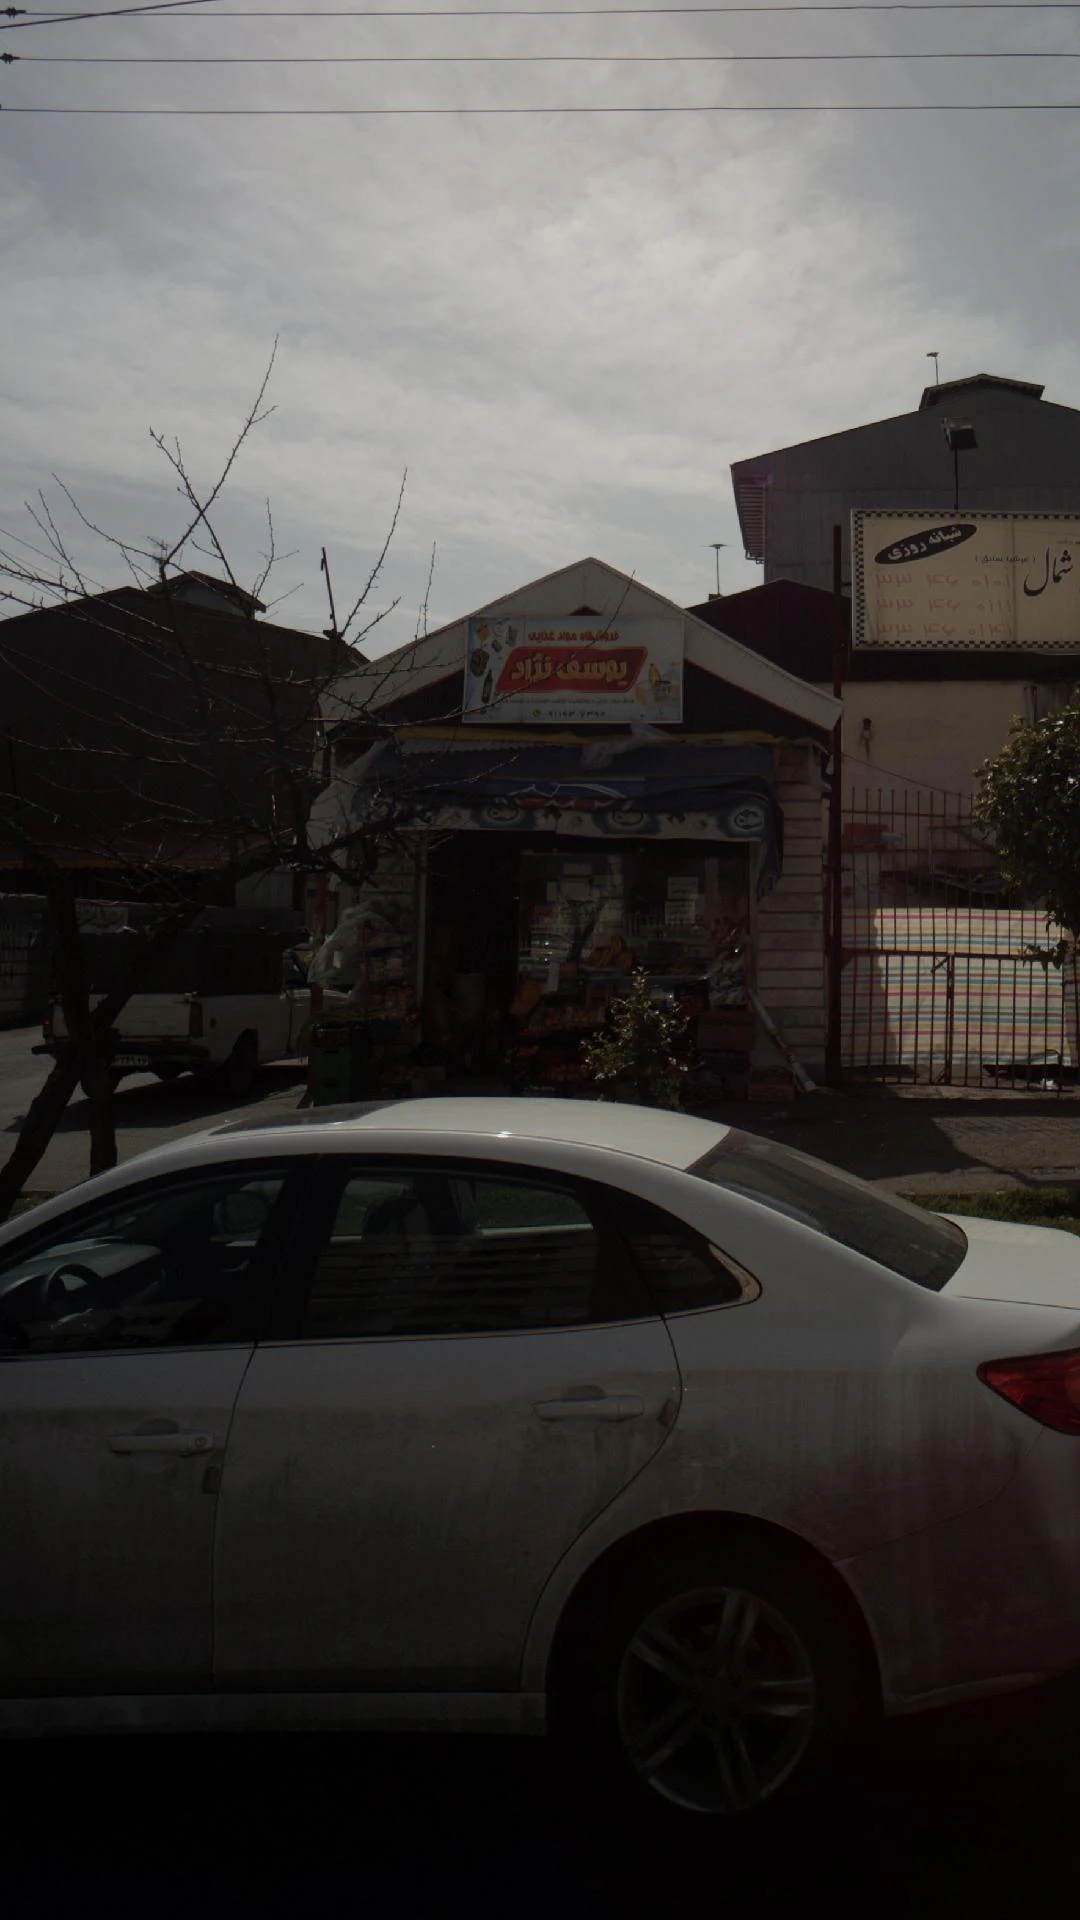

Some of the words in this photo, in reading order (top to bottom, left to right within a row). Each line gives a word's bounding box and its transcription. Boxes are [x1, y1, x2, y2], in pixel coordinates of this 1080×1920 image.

[928, 526, 962, 544] شبانه
[887, 541, 927, 560] روزی
[1023, 546, 1074, 597] شمال
[528, 631, 555, 643] غذایی
[557, 631, 577, 642] مواد
[580, 631, 619, 641] فروشگاه
[510, 652, 552, 682] نژاد
[555, 653, 627, 687] یوسف
